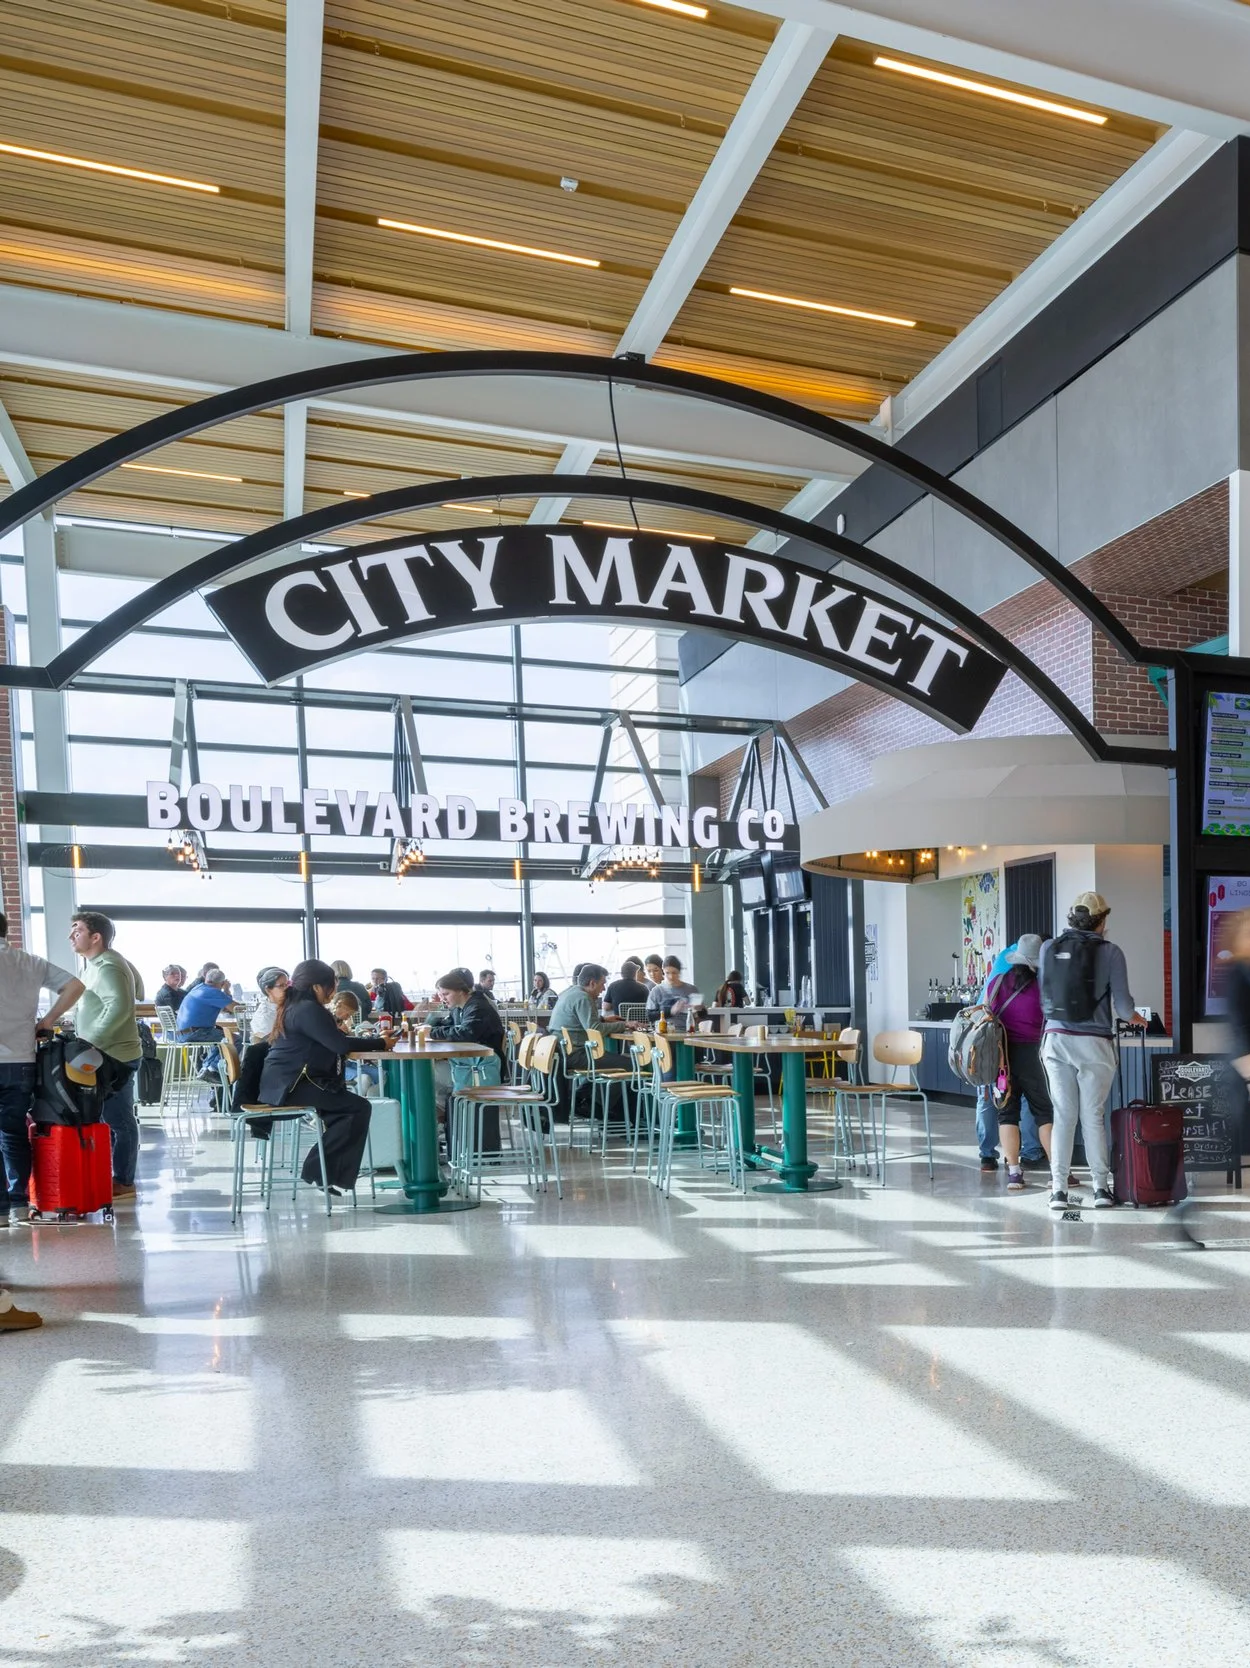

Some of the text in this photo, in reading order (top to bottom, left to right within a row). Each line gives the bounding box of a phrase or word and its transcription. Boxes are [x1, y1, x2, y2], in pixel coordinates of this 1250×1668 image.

[265, 533, 969, 696] CITY MARKET
[146, 780, 478, 839] BOULEVARD
[499, 797, 719, 850] BREWING
[1180, 1066, 1210, 1074] BOULEVARD
